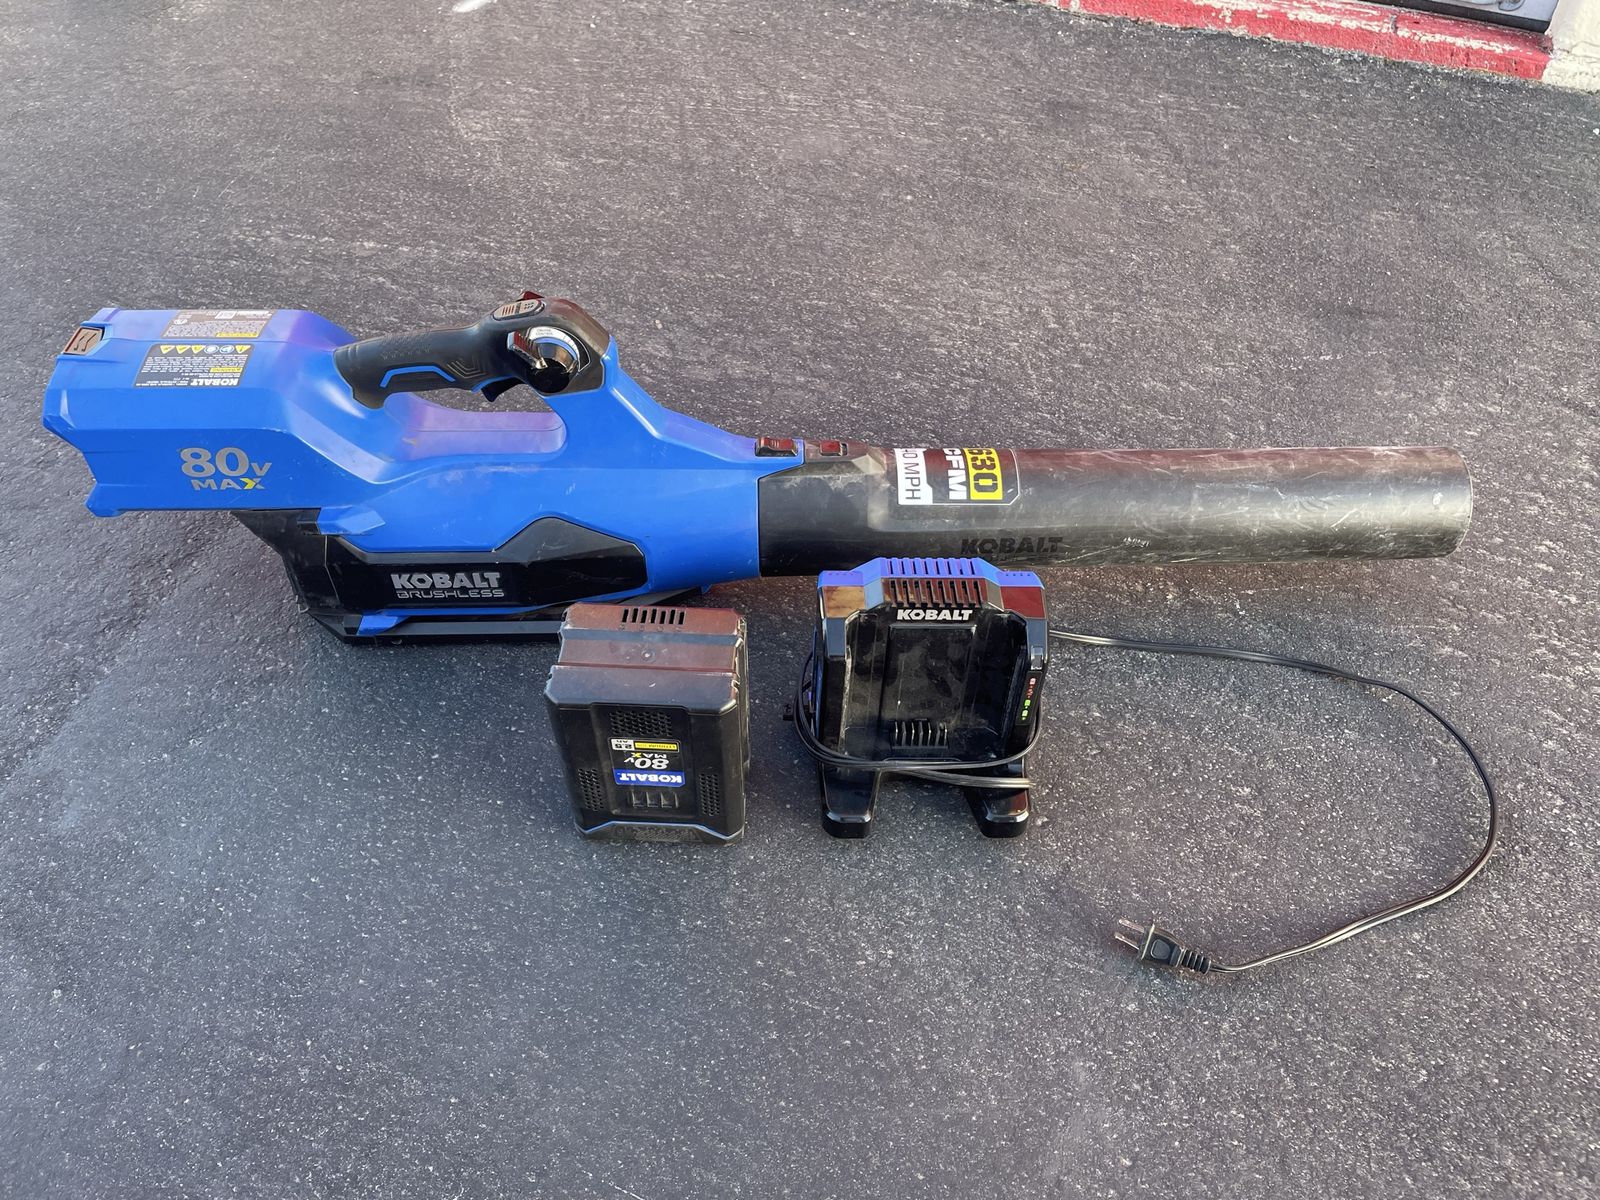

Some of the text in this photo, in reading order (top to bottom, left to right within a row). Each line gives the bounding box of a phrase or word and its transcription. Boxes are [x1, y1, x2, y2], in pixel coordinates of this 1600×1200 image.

[190, 378, 239, 386] KOBALT
[942, 448, 968, 500] CFM
[967, 448, 999, 493] 630
[190, 477, 265, 491] MAX
[903, 462, 921, 500] MPH
[960, 536, 1063, 555] KOBALT
[390, 572, 500, 589] KOBALT
[396, 589, 505, 599] BRUSHLESS
[896, 608, 973, 621] KOBALT
[619, 772, 682, 783] KOBALT
